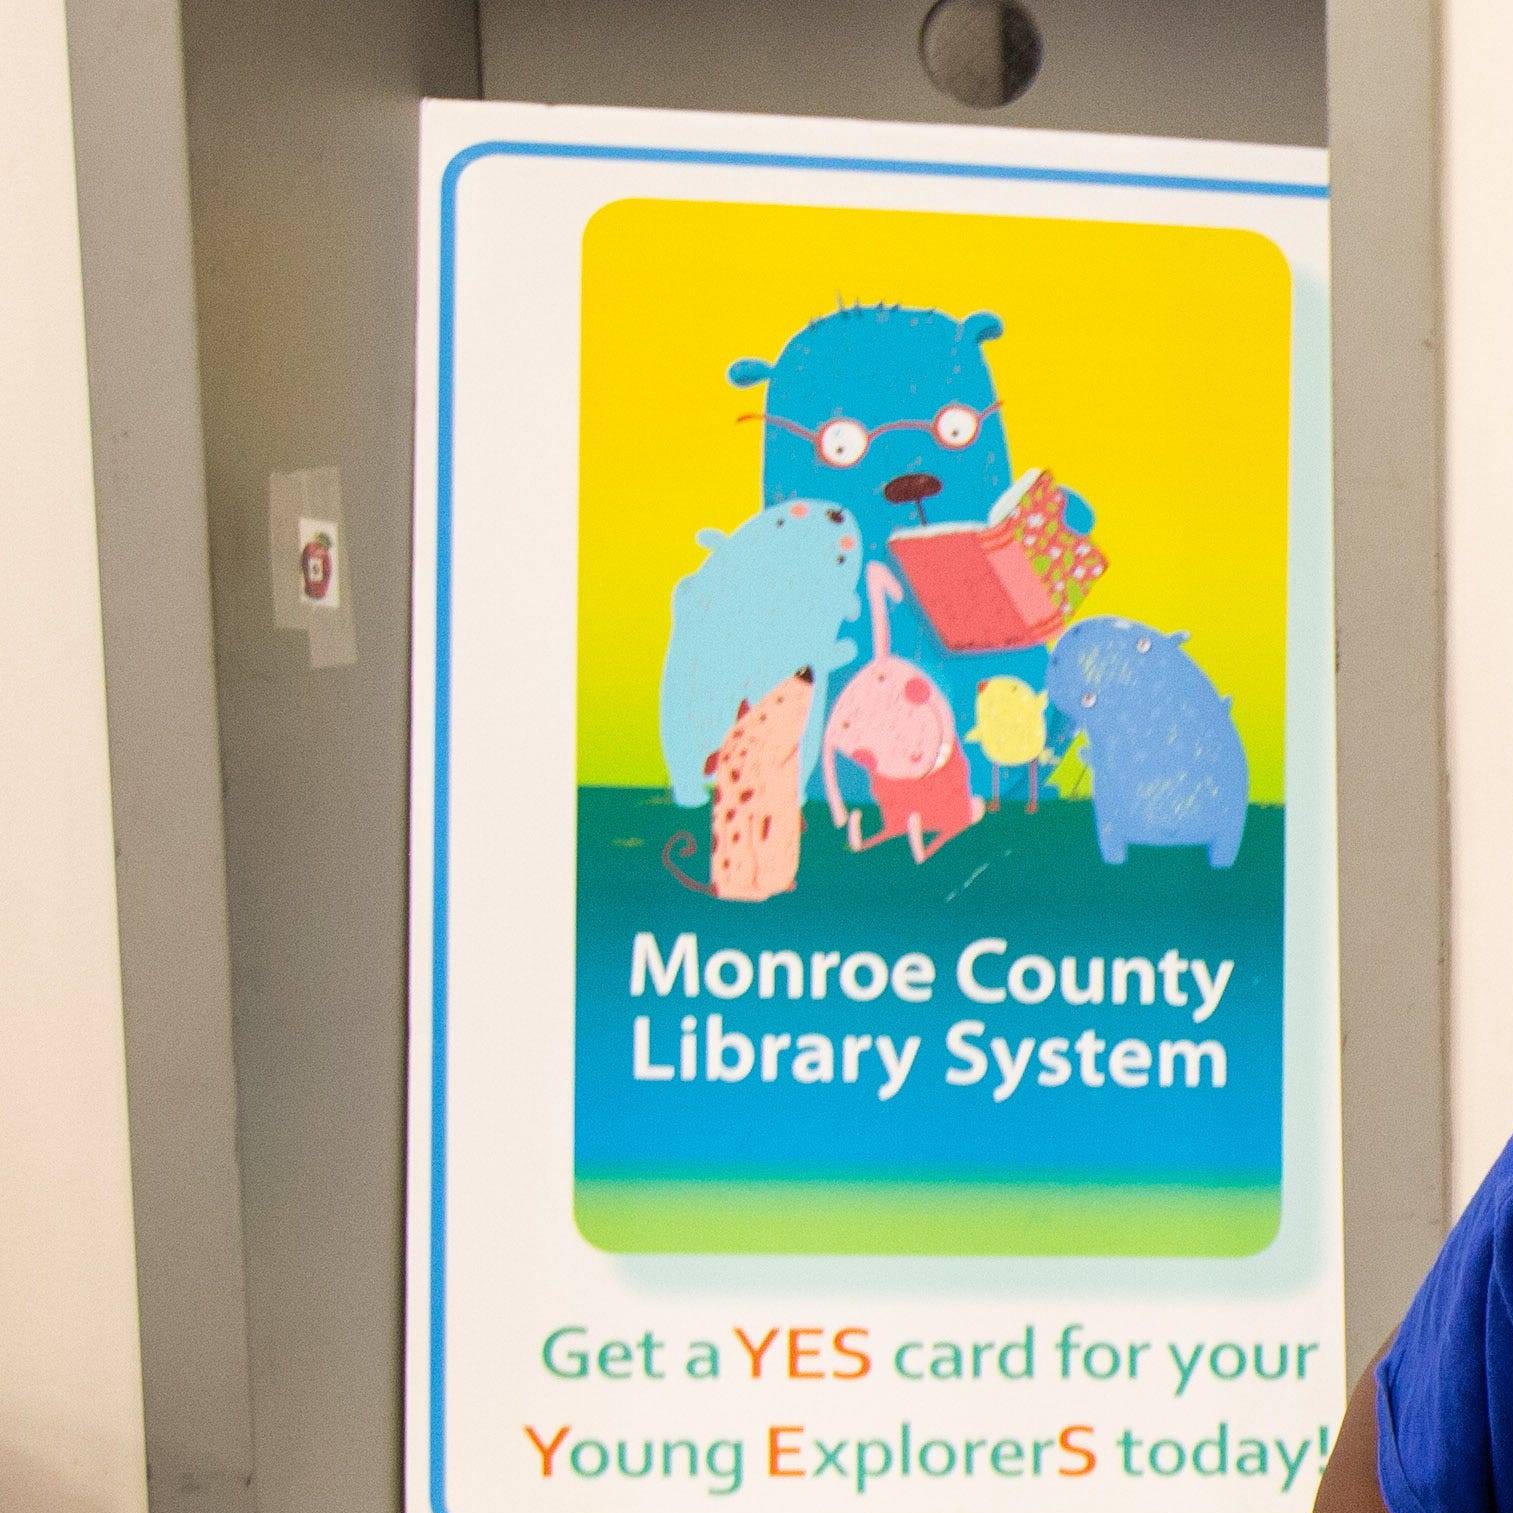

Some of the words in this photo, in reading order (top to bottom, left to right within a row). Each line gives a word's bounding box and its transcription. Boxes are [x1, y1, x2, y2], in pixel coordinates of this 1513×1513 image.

[631, 932, 935, 1002] Monroe
[953, 938, 1234, 1022] County
[634, 1014, 921, 1100] Library
[946, 1020, 1227, 1102] System
[541, 1326, 666, 1380] Get
[685, 1344, 720, 1380] a
[732, 1325, 874, 1382] YES
[892, 1326, 1035, 1381] card
[1056, 1325, 1151, 1380] for
[1169, 1344, 1321, 1395] your
[523, 1424, 744, 1494] Young
[766, 1423, 1098, 1494] ExplorerS
[1117, 1424, 1336, 1494] today!
